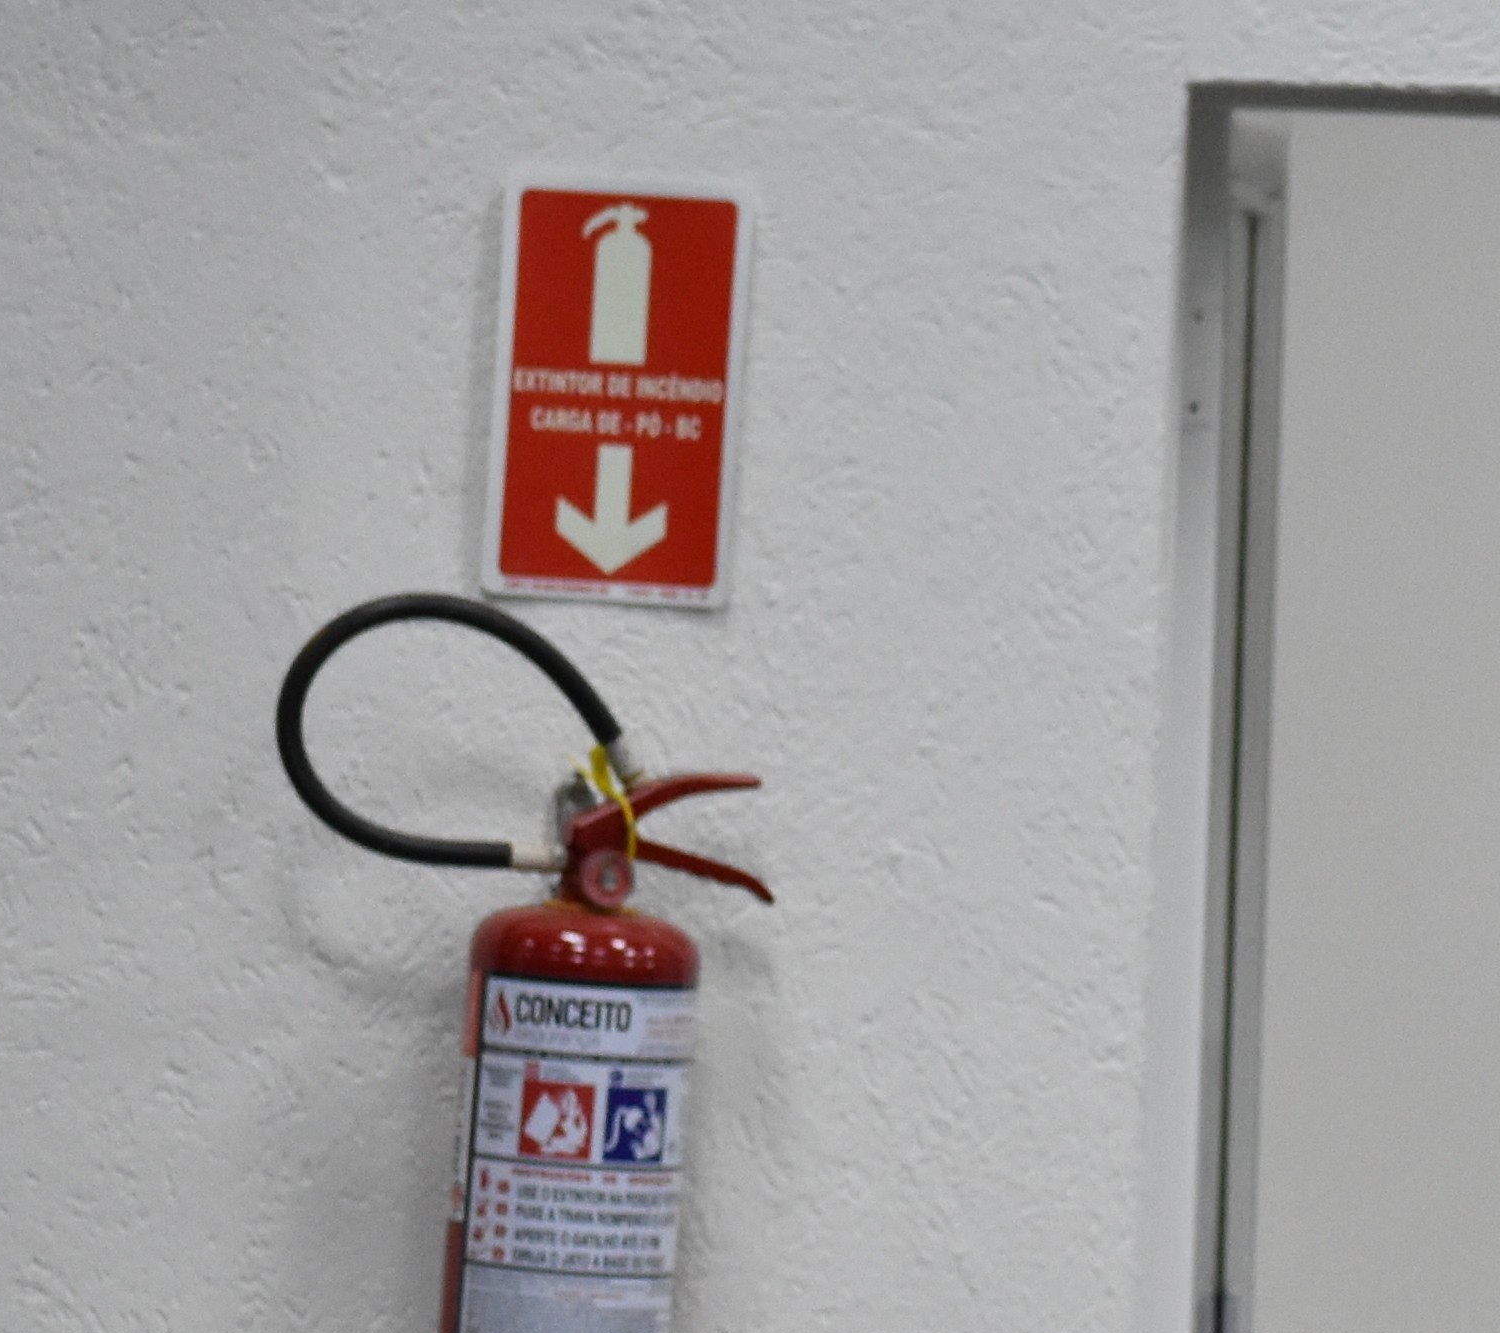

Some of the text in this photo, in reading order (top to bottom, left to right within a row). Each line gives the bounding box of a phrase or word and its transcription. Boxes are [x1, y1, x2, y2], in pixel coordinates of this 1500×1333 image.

[513, 367, 603, 395] EXTINTOR
[607, 372, 630, 398] DE
[528, 405, 593, 433] CARGA
[515, 992, 633, 1032] CONCEITO
